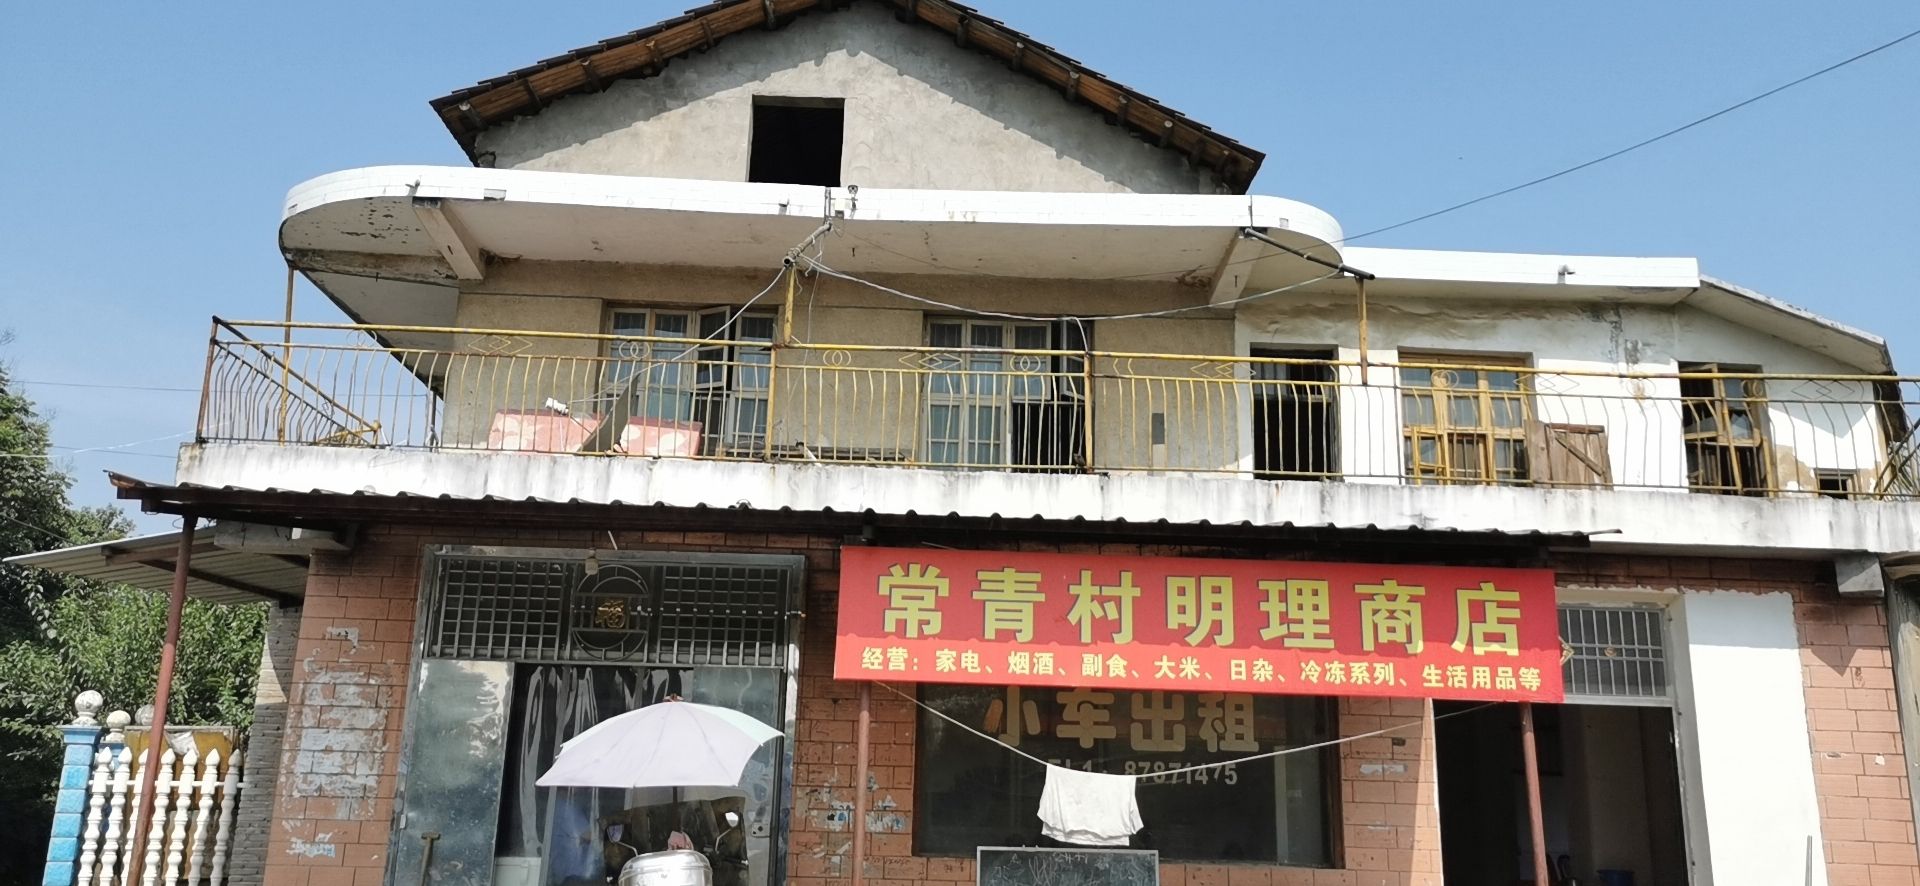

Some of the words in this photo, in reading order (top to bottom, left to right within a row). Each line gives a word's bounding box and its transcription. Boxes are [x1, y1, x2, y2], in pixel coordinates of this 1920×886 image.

[878, 563, 1521, 656] 常青村明理商店
[983, 686, 1259, 752] 小车出租
